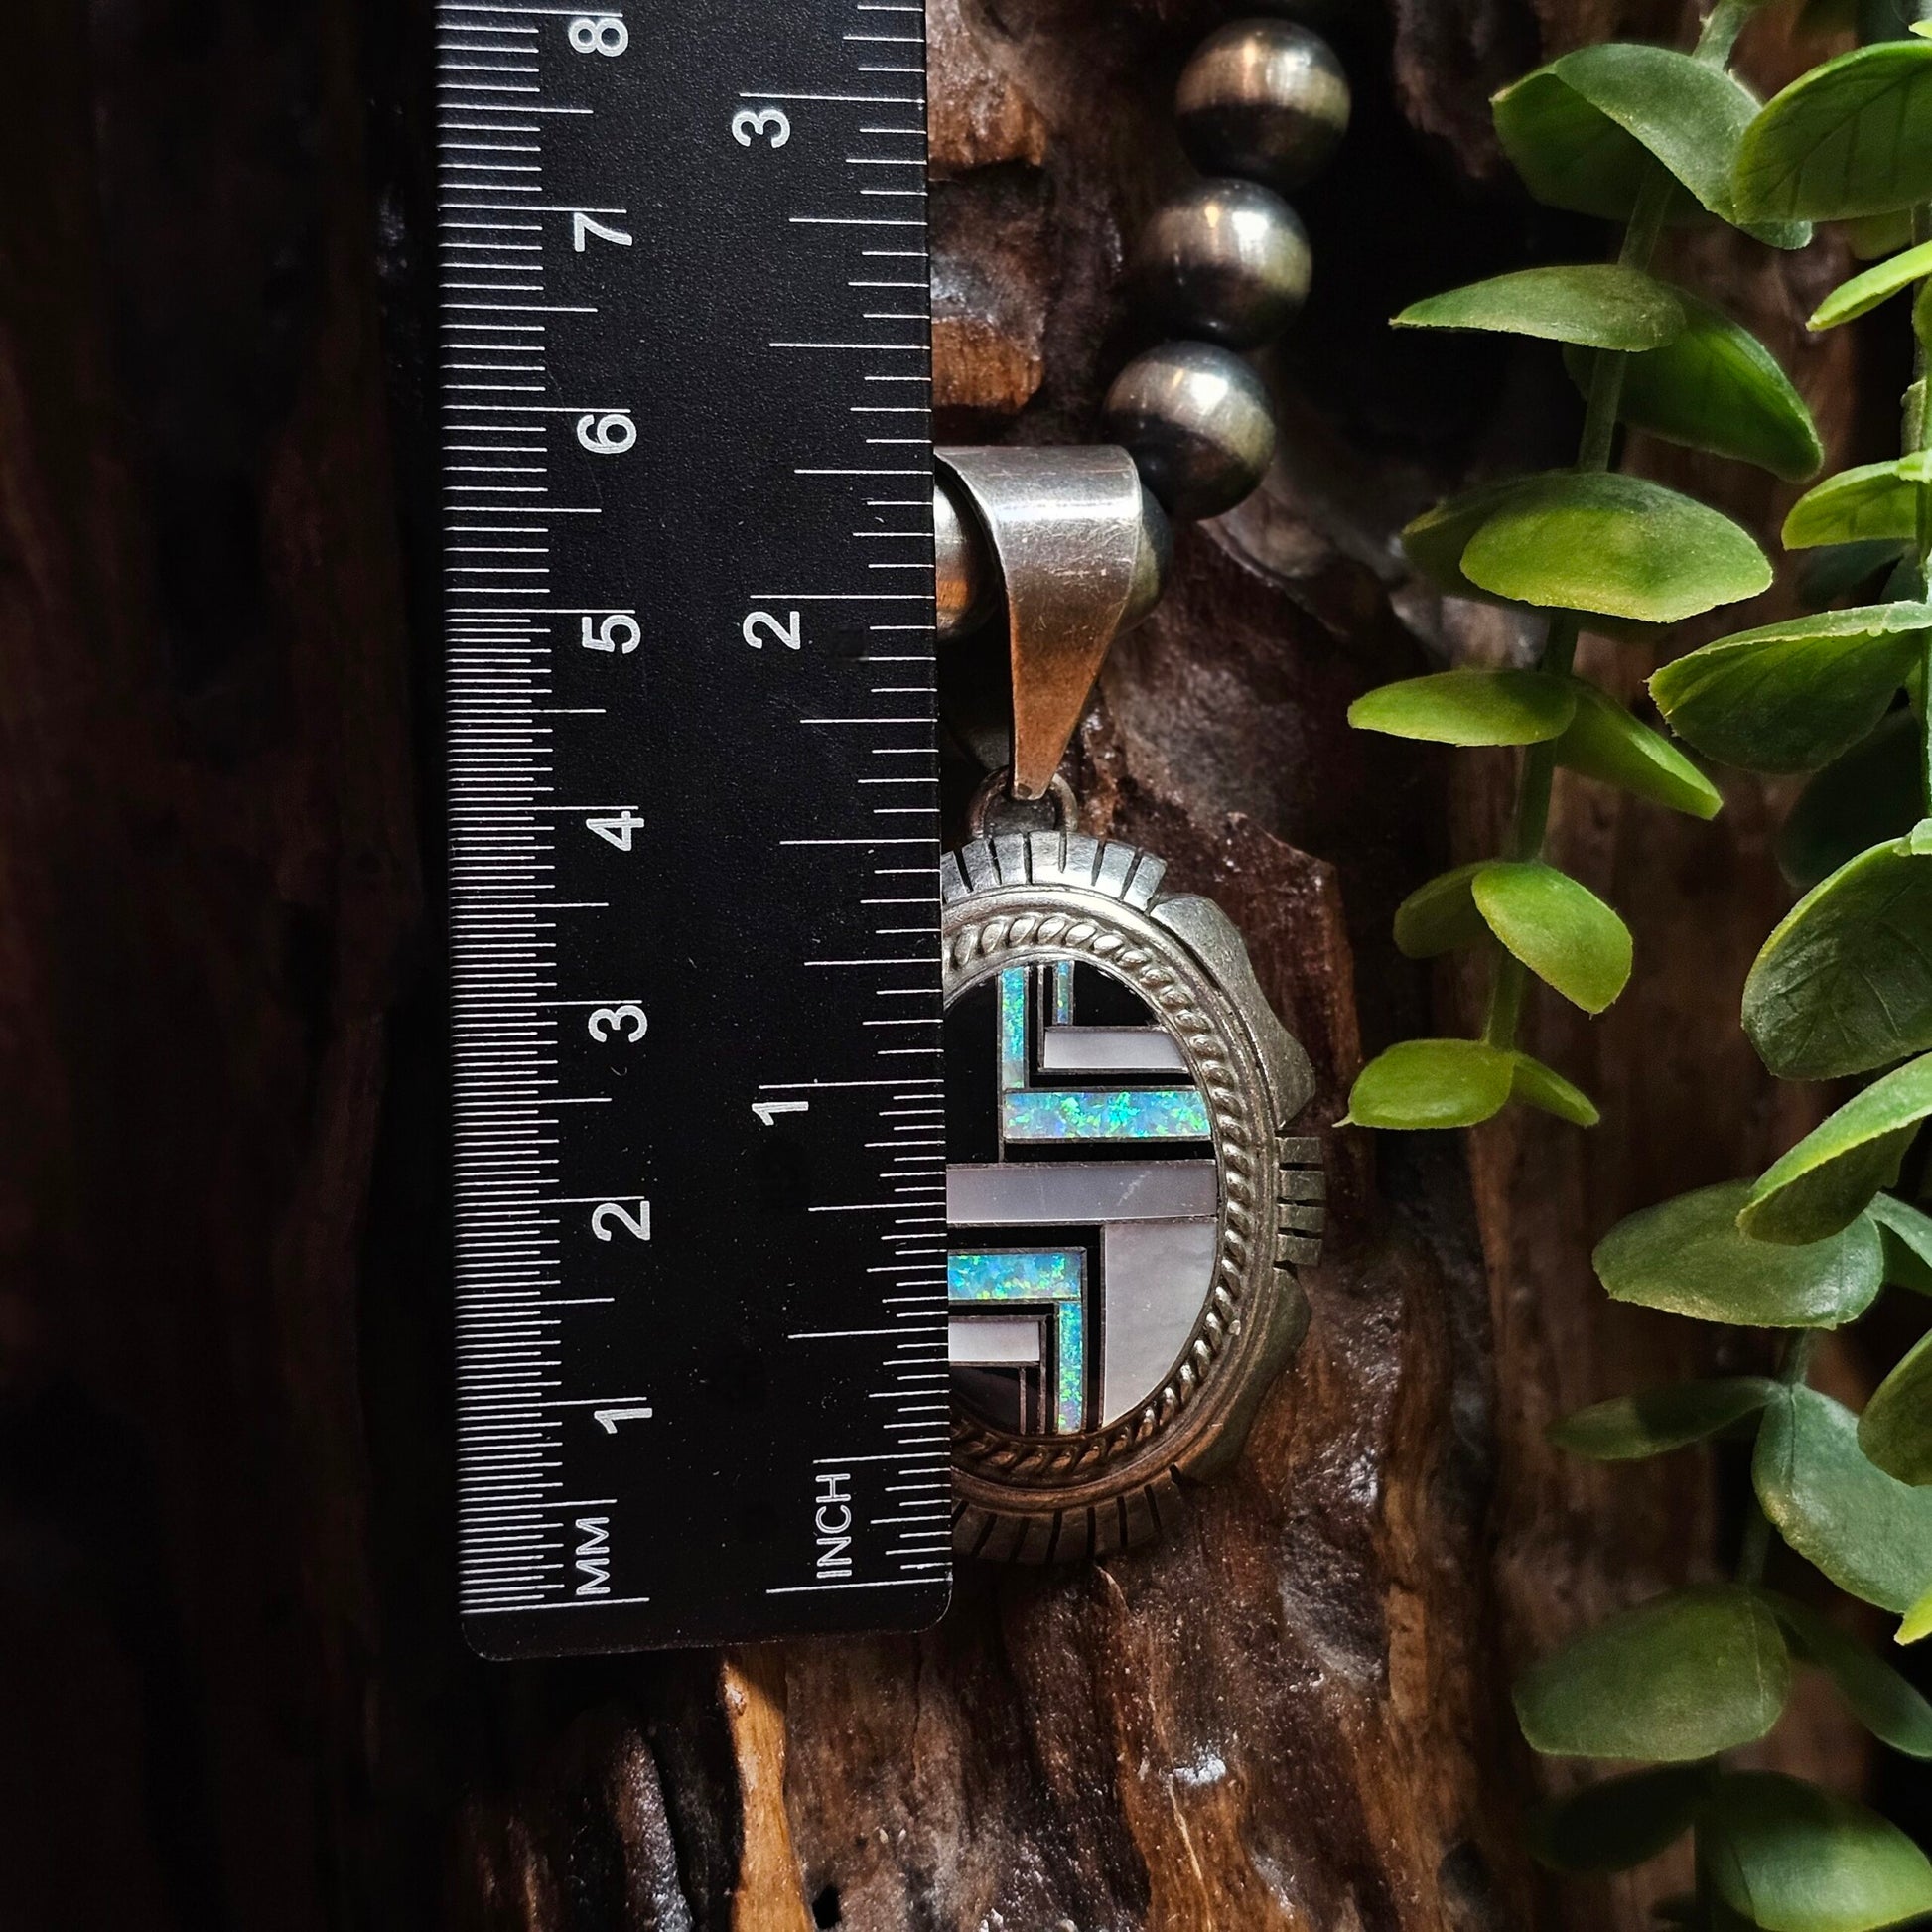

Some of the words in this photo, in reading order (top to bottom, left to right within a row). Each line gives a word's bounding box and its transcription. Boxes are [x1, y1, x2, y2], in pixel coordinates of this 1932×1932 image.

[568, 16, 629, 58] 8
[732, 106, 791, 149] 3
[573, 212, 633, 253] 7
[577, 413, 637, 455] 6
[582, 614, 641, 655] 5
[743, 610, 801, 650] 2
[586, 810, 645, 852] 4
[588, 1004, 648, 1043] 3
[752, 1100, 810, 1126] 1
[592, 1200, 651, 1242] 2
[594, 1407, 653, 1435] 1
[815, 1473, 853, 1579] INCH
[575, 1516, 611, 1596] MM
